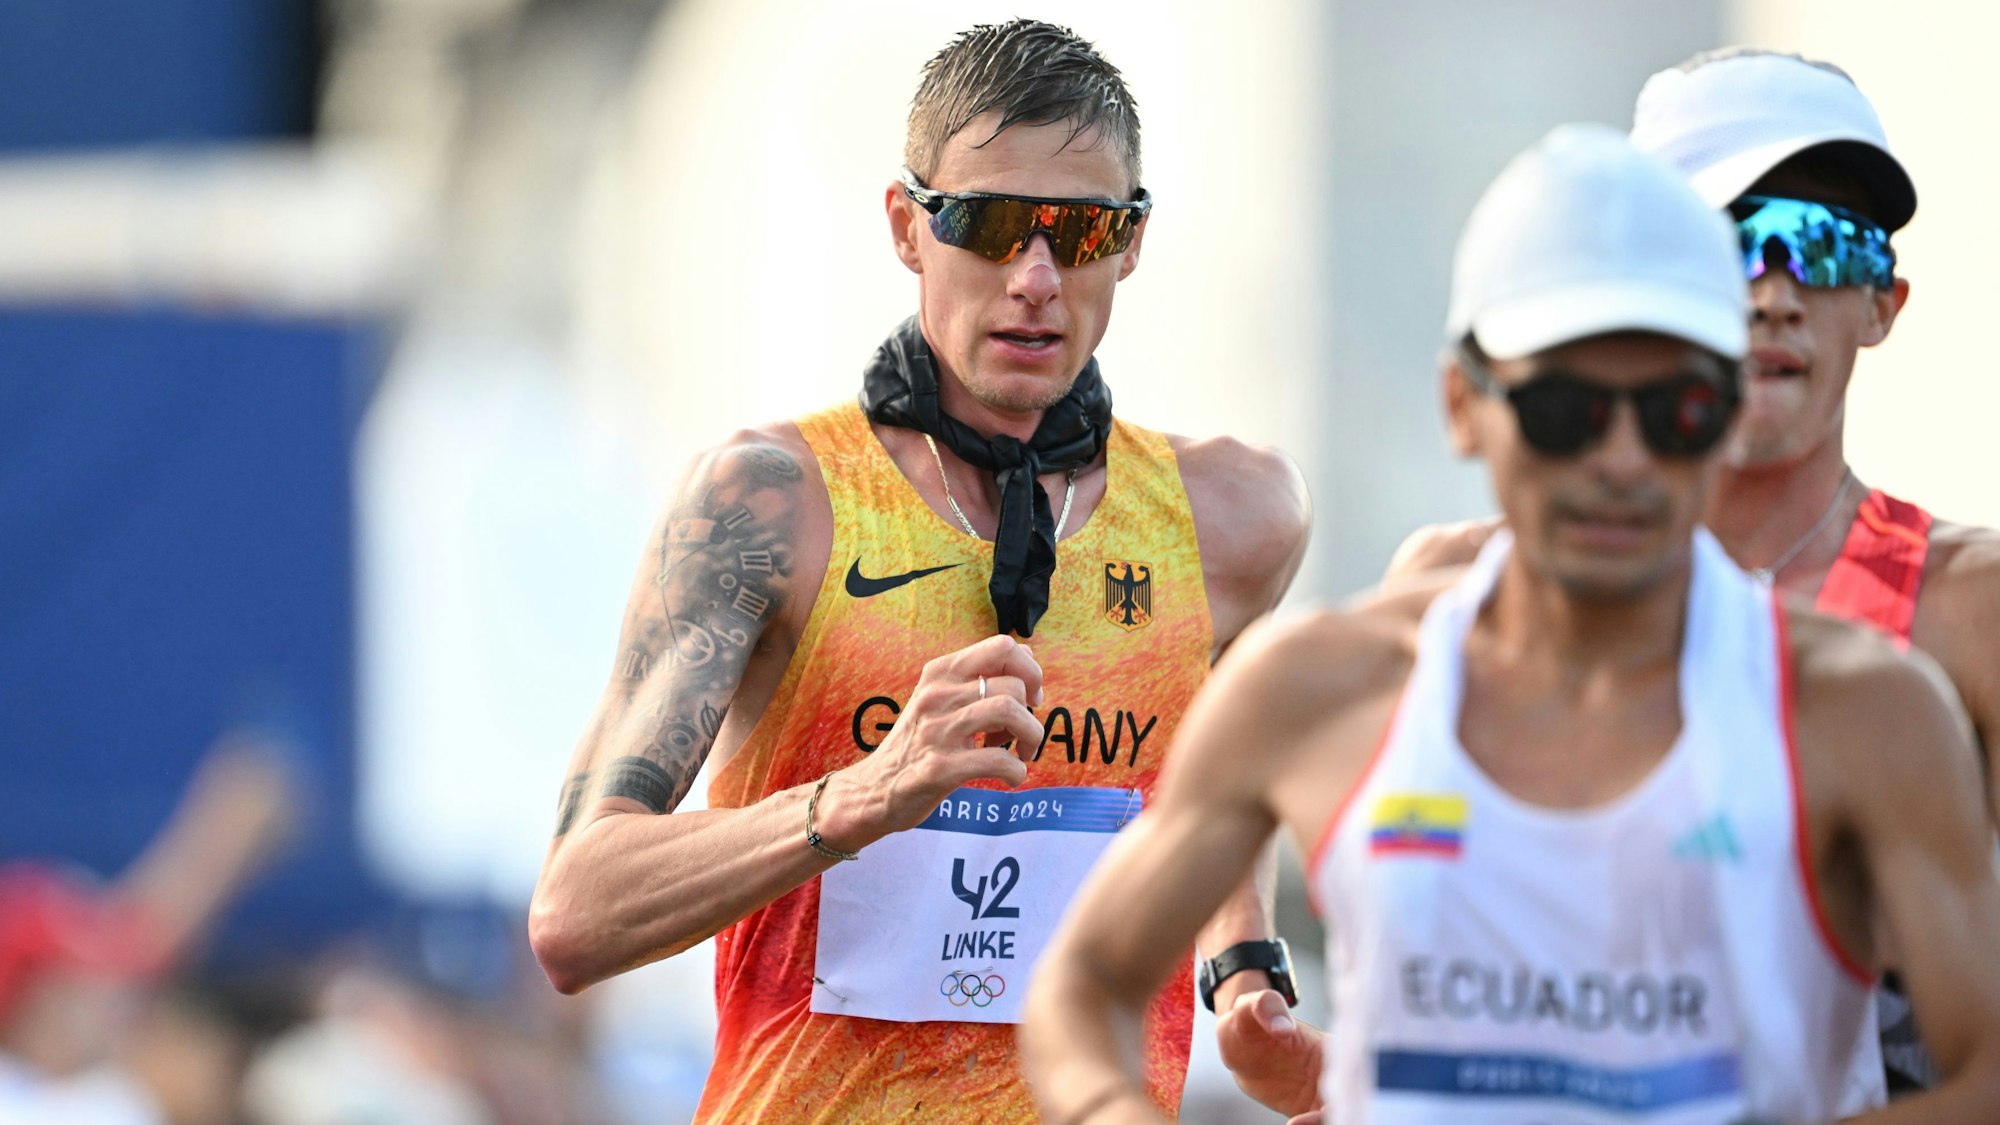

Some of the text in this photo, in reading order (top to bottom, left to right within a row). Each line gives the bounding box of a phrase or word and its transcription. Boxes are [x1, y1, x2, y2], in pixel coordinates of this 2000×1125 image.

[852, 696, 1157, 767] GANY
[1008, 800, 1064, 823] 2024
[950, 856, 1020, 921] 42
[941, 931, 1016, 960] LINKE
[1401, 954, 1710, 1036] ECUADOR
